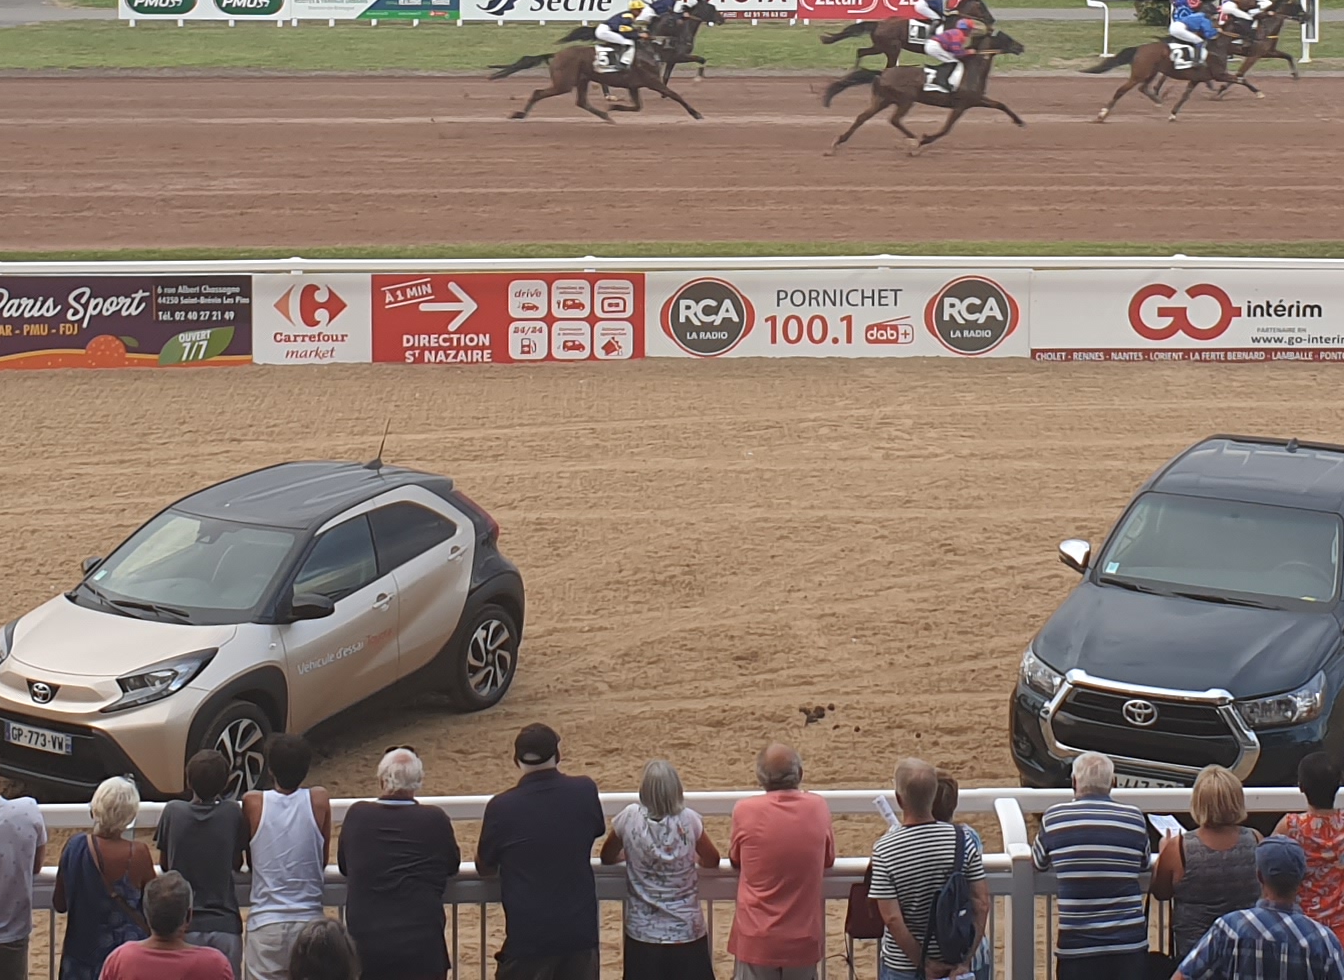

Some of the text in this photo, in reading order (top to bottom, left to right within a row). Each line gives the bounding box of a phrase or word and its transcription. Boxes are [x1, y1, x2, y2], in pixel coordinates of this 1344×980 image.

[396, 290, 405, 301] 1
[406, 283, 433, 299] MIN
[514, 288, 542, 298] drive
[776, 288, 903, 307] PORNICHET
[67, 286, 150, 328] Sport
[678, 299, 740, 326] RCA
[943, 297, 1004, 324] RCA
[1128, 283, 1322, 340] GO intérim
[175, 311, 185, 320] 02
[187, 311, 197, 320] 40
[199, 311, 210, 320] 27
[212, 311, 222, 320] 21
[224, 311, 235, 320] 49
[23, 323, 49, 336] PMU
[59, 323, 79, 335] FDJ
[178, 329, 212, 343] OUVERT
[686, 331, 728, 340] LA RADIO
[764, 314, 855, 345] 100.1
[950, 330, 992, 339] LA RADIO
[273, 332, 348, 344] Carrefour
[402, 333, 490, 348] DIRECTION
[181, 340, 208, 362] 7/7
[284, 347, 336, 360] market
[424, 349, 492, 363] NAZAIRE
[1035, 352, 1067, 360] CHOLET
[1072, 352, 1104, 360] RENNES
[1111, 352, 1143, 360] NANTES
[1150, 352, 1184, 360] LORIENT
[1190, 352, 1200, 360] LA
[1227, 352, 1265, 360] BERNARD
[1272, 352, 1313, 360] LAMBALLE
